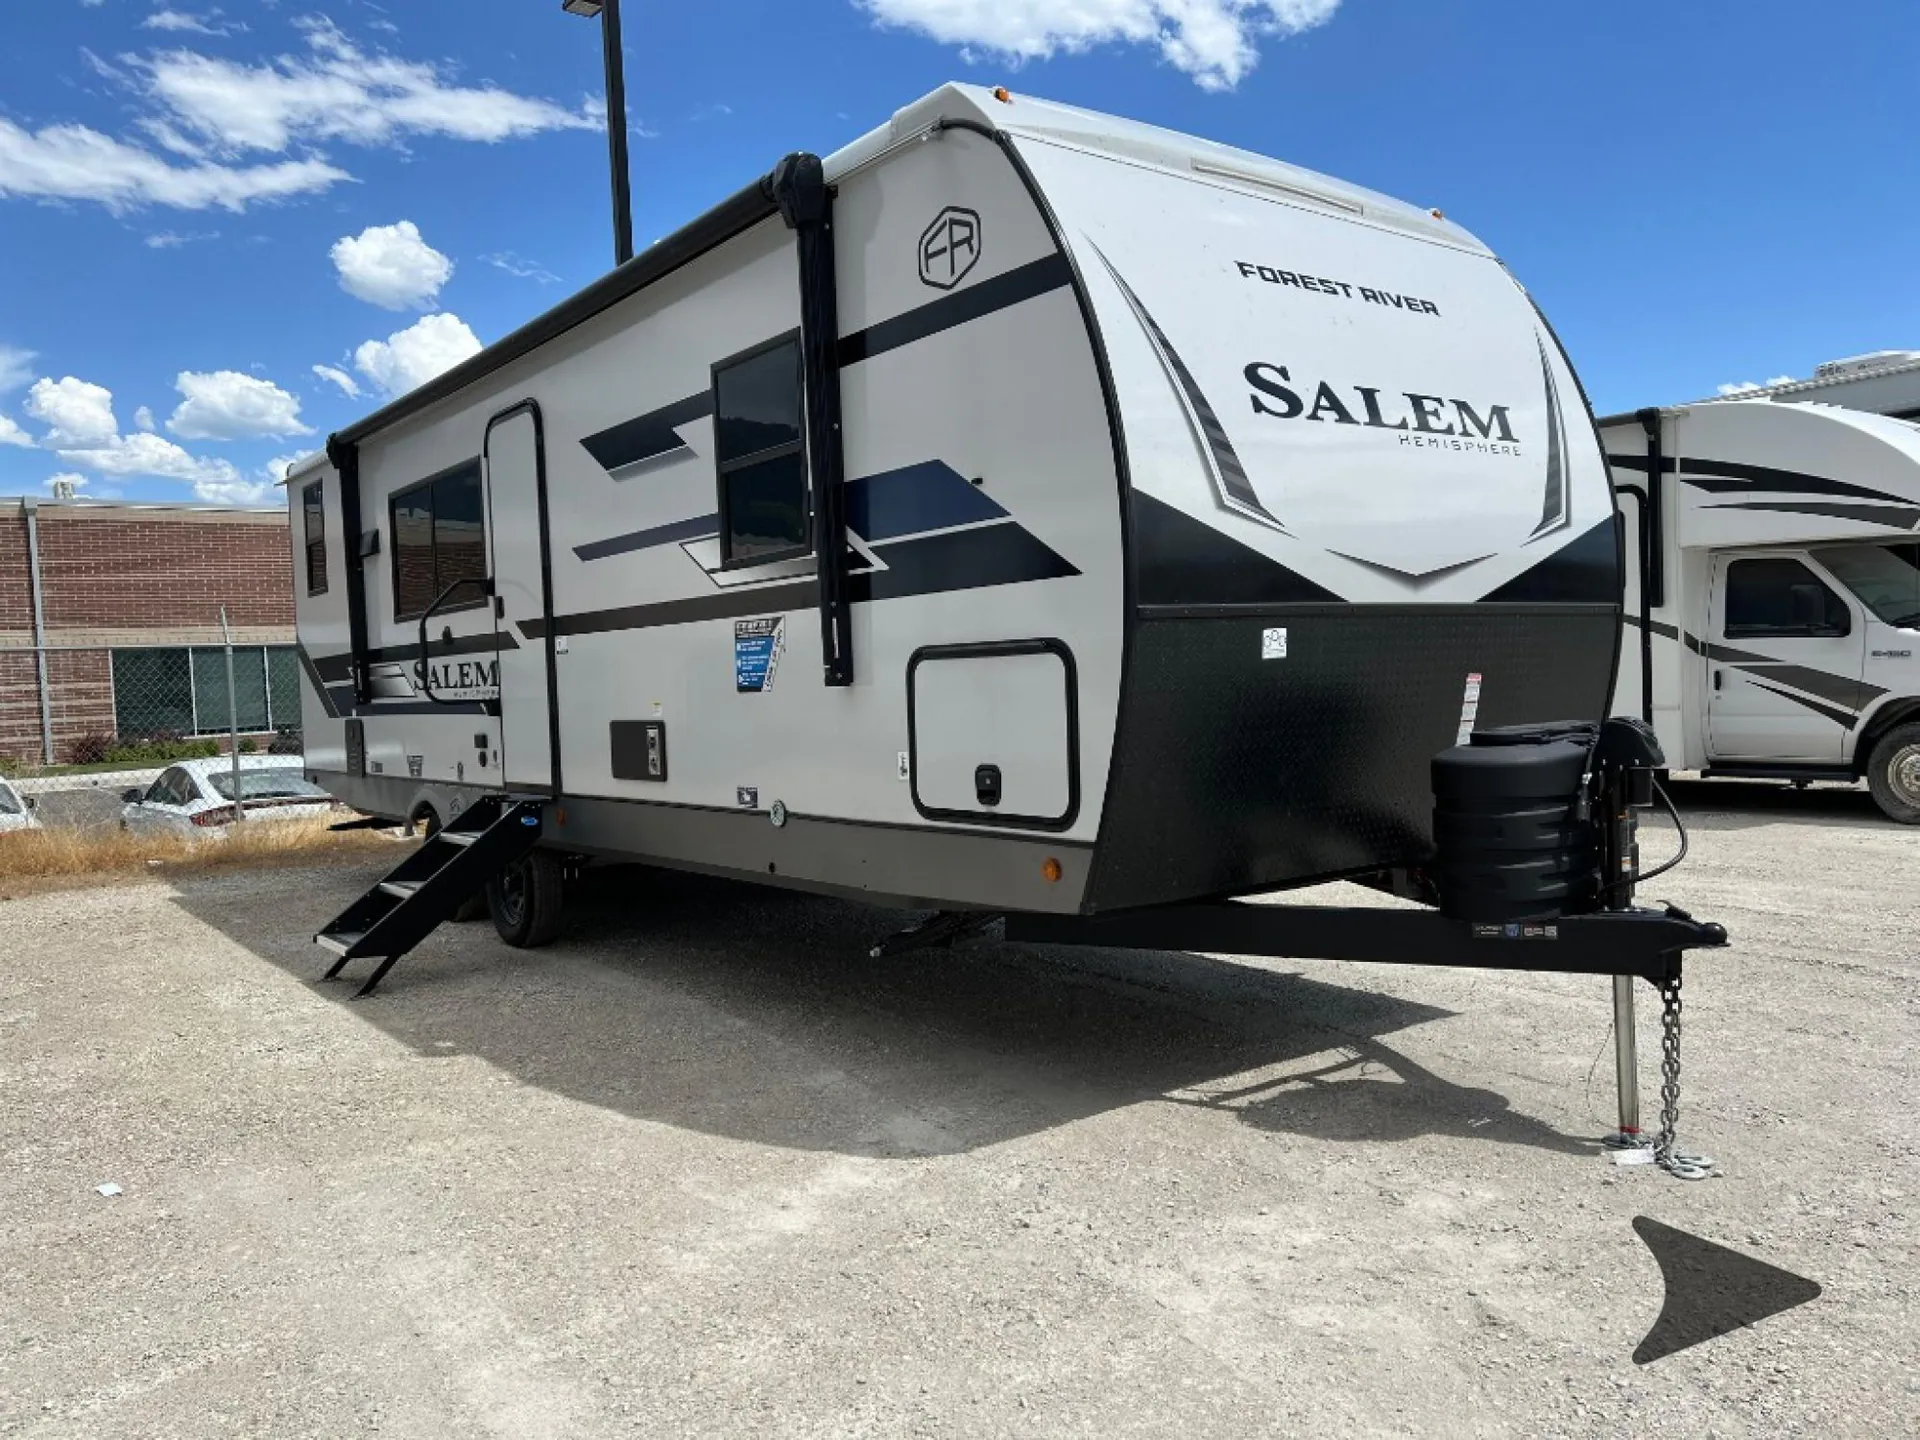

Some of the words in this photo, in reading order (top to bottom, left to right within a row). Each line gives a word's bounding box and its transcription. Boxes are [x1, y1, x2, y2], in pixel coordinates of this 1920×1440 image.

[1235, 260, 1353, 299] FOREST
[1358, 286, 1441, 316] RIVER
[1244, 360, 1520, 443] SALEM
[1398, 434, 1522, 456] HEMISPHERE
[413, 659, 499, 690] SALEM
